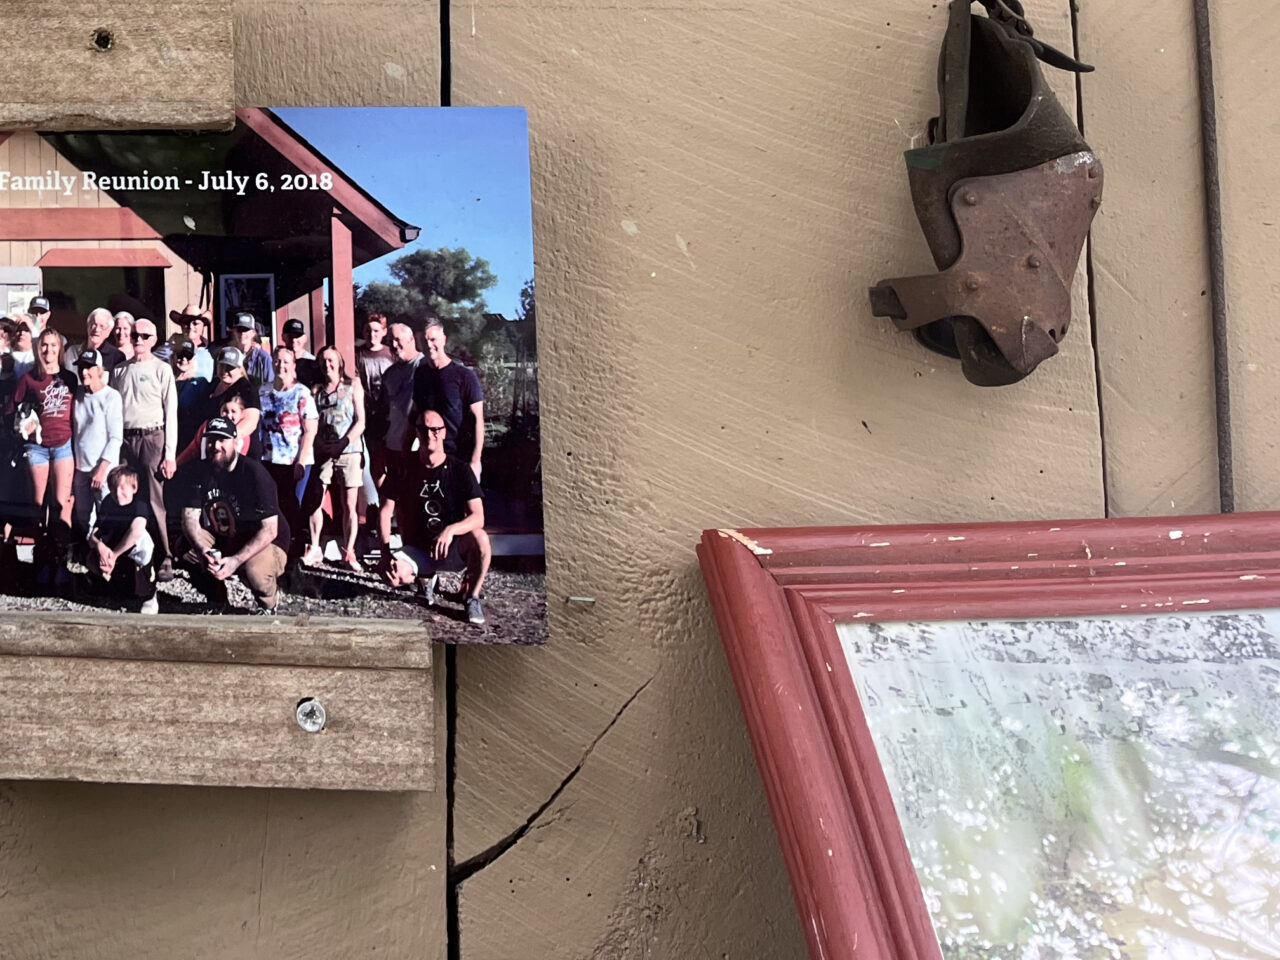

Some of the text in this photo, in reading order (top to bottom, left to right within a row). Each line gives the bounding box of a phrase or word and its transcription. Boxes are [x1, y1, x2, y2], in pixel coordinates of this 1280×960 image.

[81, 170, 180, 191] Reunion
[198, 170, 250, 196] July
[254, 172, 275, 193] 6,
[280, 172, 334, 191] 2018
